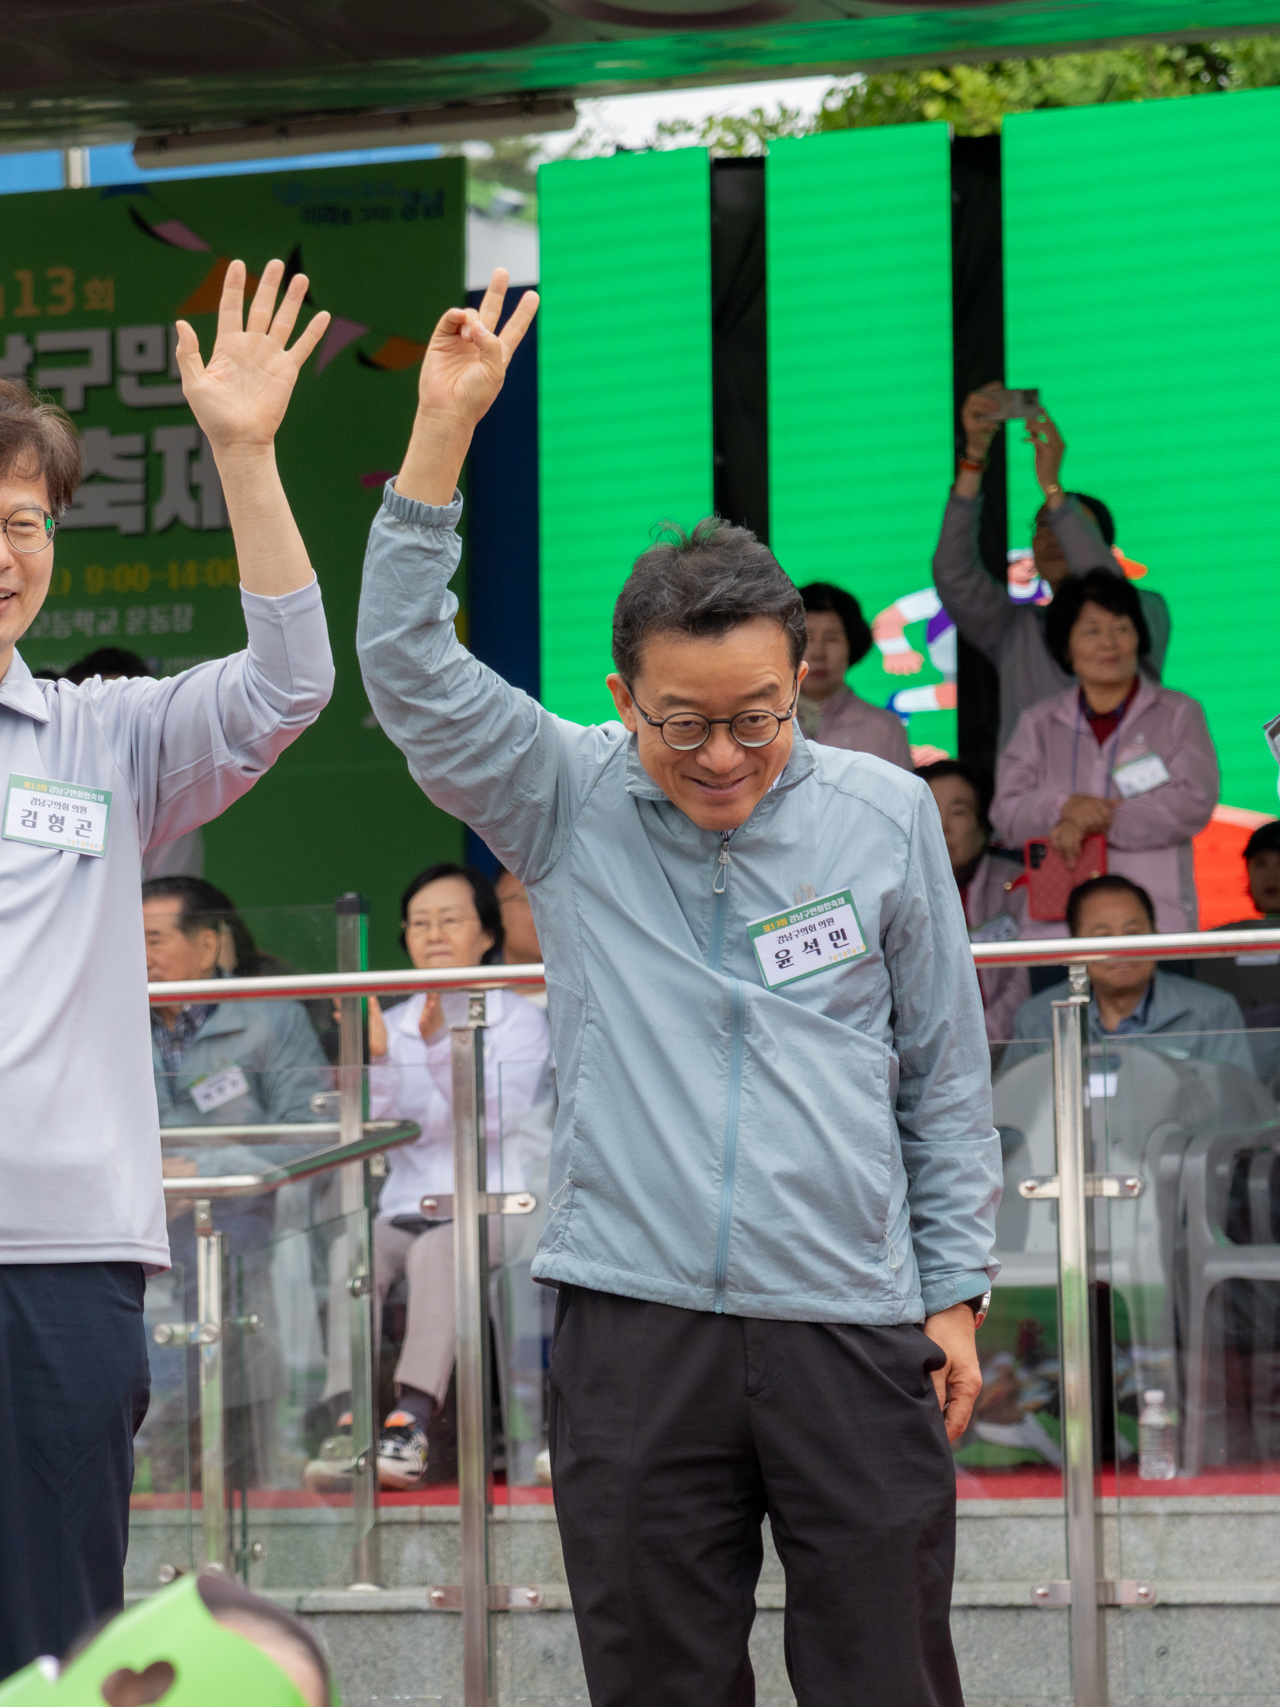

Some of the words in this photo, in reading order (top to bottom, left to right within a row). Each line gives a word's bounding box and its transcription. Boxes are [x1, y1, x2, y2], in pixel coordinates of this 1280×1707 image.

[30, 796, 70, 812] 강남구의회
[71, 804, 88, 815] 의원
[776, 924, 817, 944] 강남구의회
[818, 917, 835, 929] 의원
